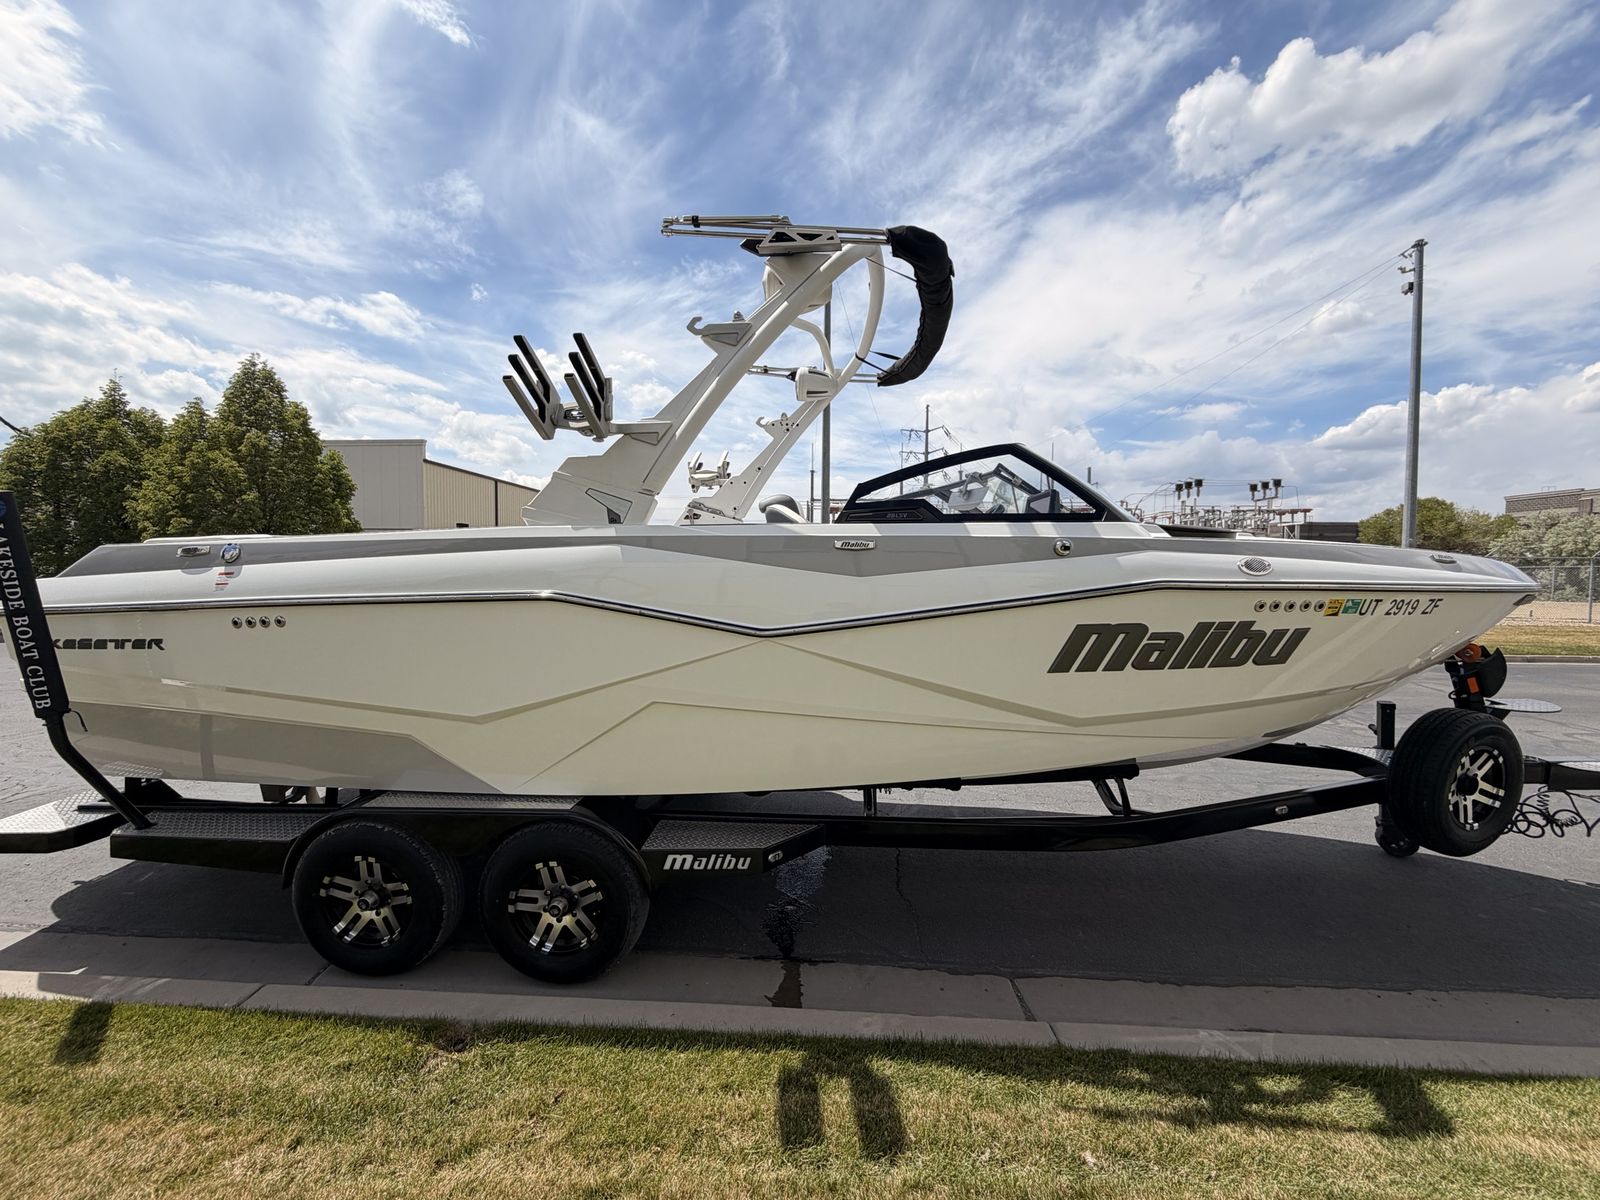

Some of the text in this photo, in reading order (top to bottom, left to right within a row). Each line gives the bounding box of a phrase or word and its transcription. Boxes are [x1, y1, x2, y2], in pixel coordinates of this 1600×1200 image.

[0, 523, 52, 709] KESIDE BOAT CLUB
[1358, 598, 1383, 616] UT
[1384, 598, 1420, 616] 2919
[1421, 598, 1444, 615] ZF
[52, 638, 165, 650] KESETTER
[1046, 620, 1311, 673] Malibu
[662, 853, 752, 871] Malibu
